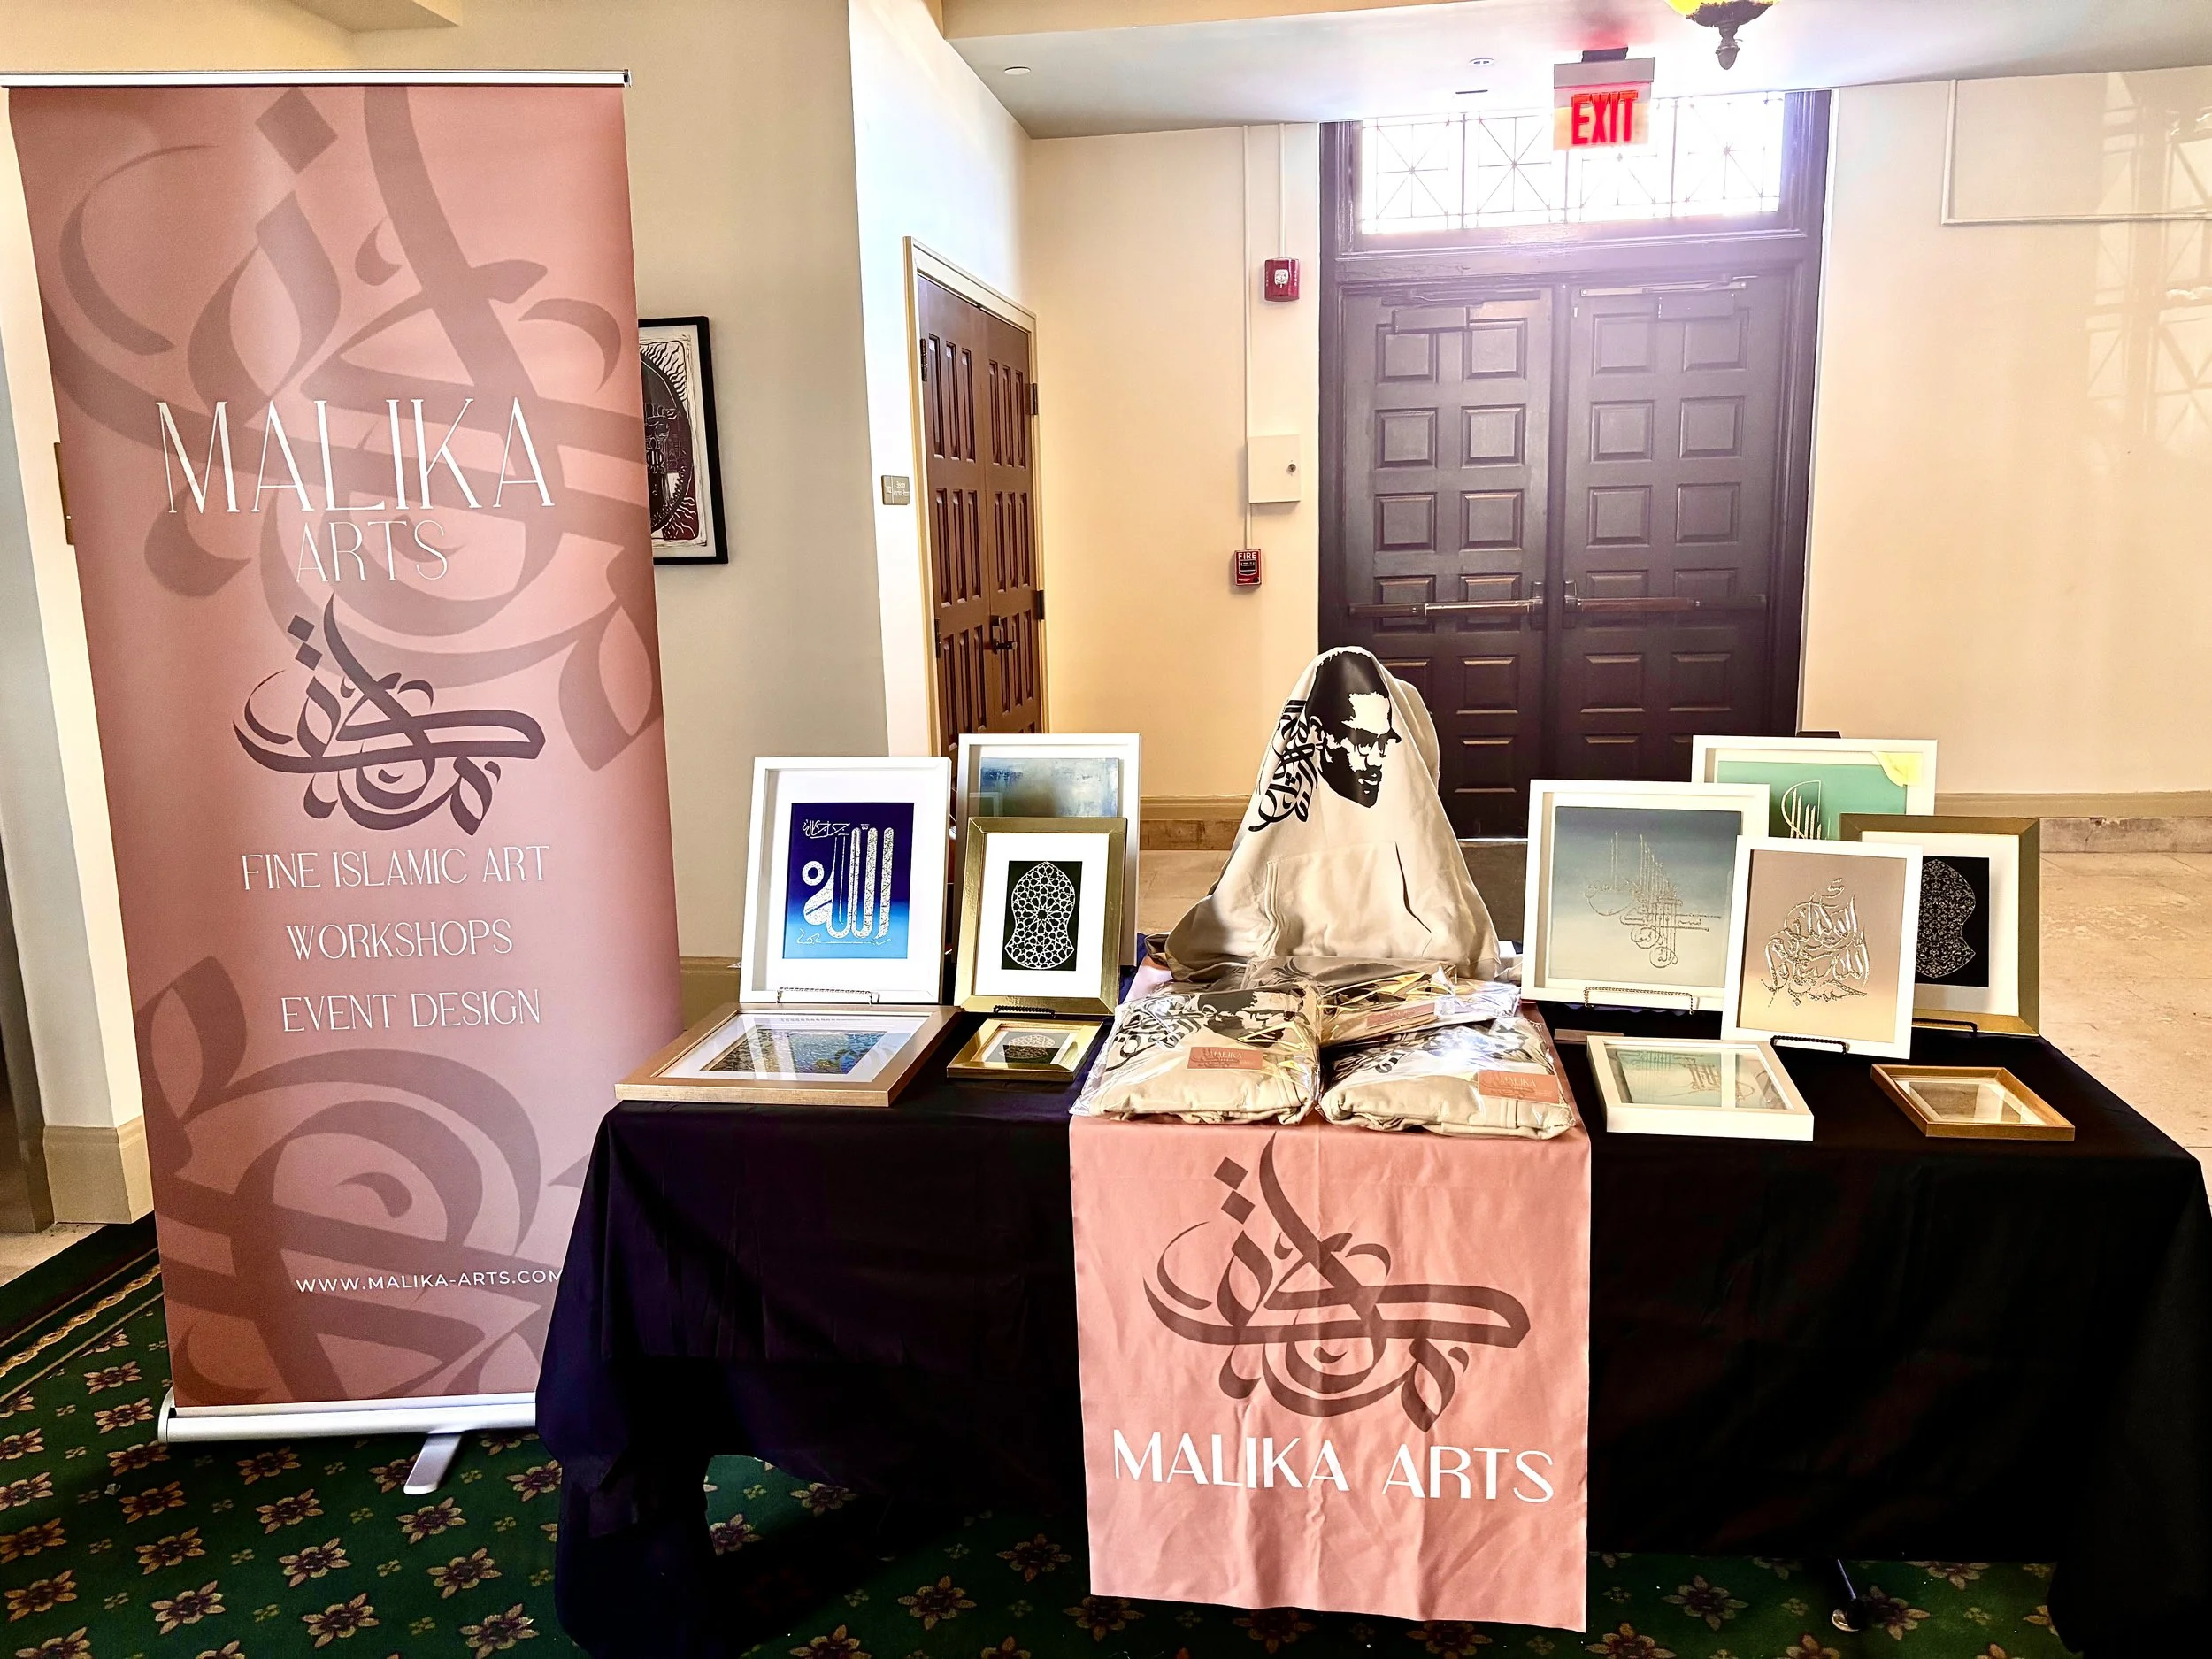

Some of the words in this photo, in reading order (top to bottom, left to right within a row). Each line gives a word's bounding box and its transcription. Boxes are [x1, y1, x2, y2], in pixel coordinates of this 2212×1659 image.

[1571, 90, 1638, 145] EXIT
[156, 397, 555, 513] MALIKA
[296, 519, 449, 582] ARTS
[241, 852, 321, 890] FINE
[333, 848, 468, 887] ISLAMIC
[482, 845, 550, 883] ART
[286, 918, 513, 960] WORKSHOPS
[280, 993, 396, 1032] EVENT
[410, 989, 541, 1028] DESIGN
[296, 1269, 563, 1293] WWW.MALIKA-ARTS.COM
[1113, 1429, 1349, 1492] MALIKA
[1382, 1443, 1555, 1503] ARTS
